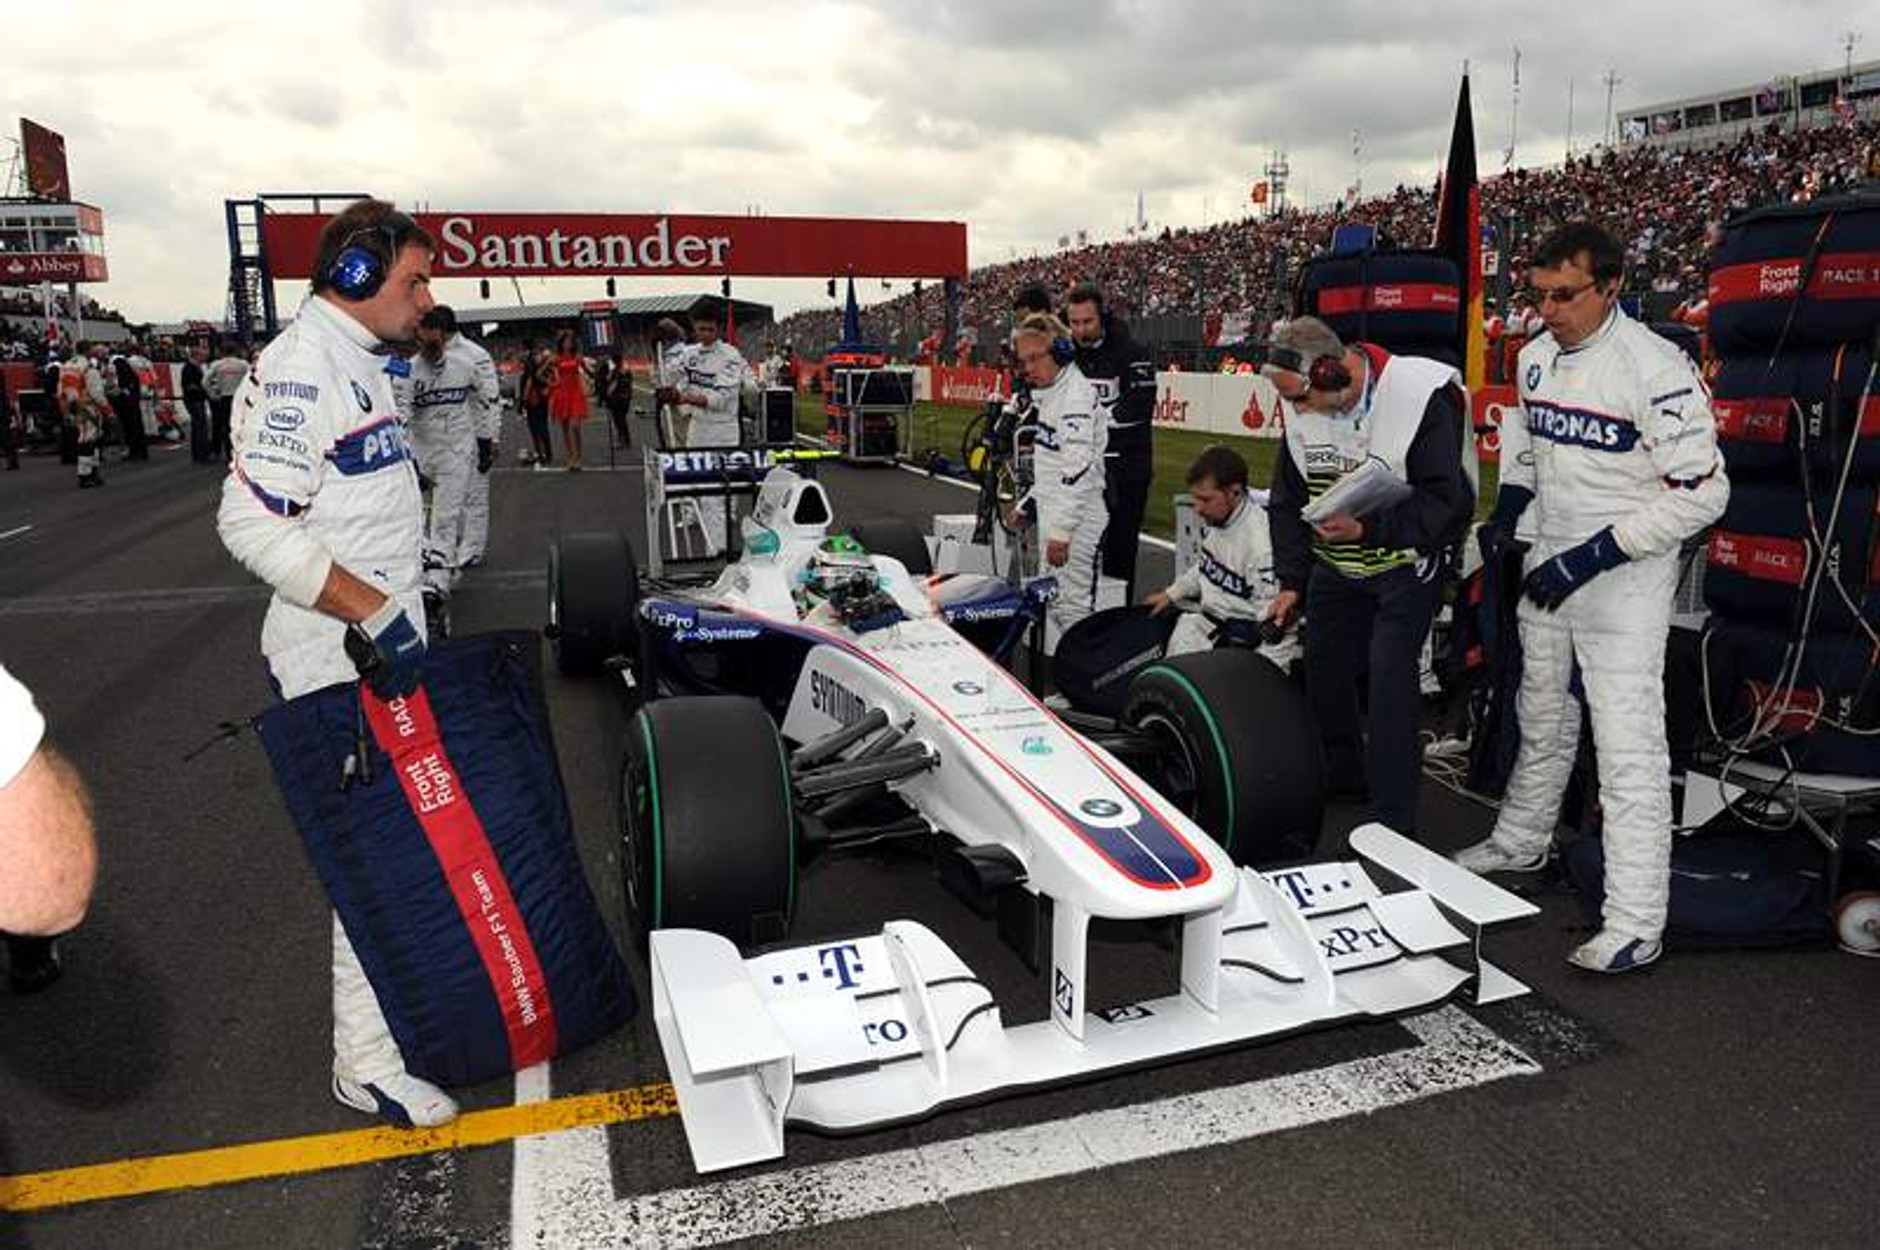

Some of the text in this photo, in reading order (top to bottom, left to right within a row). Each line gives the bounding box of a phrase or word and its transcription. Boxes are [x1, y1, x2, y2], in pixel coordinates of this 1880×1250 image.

[441, 216, 732, 269] Santander
[31, 257, 80, 276] Abbey
[1760, 264, 1801, 280] Front
[1760, 279, 1800, 294] Right
[407, 760, 438, 813] Front
[422, 753, 456, 806] Right
[472, 868, 538, 1027] BMW Sauber F1 Team
[862, 1019, 908, 1045] ro
